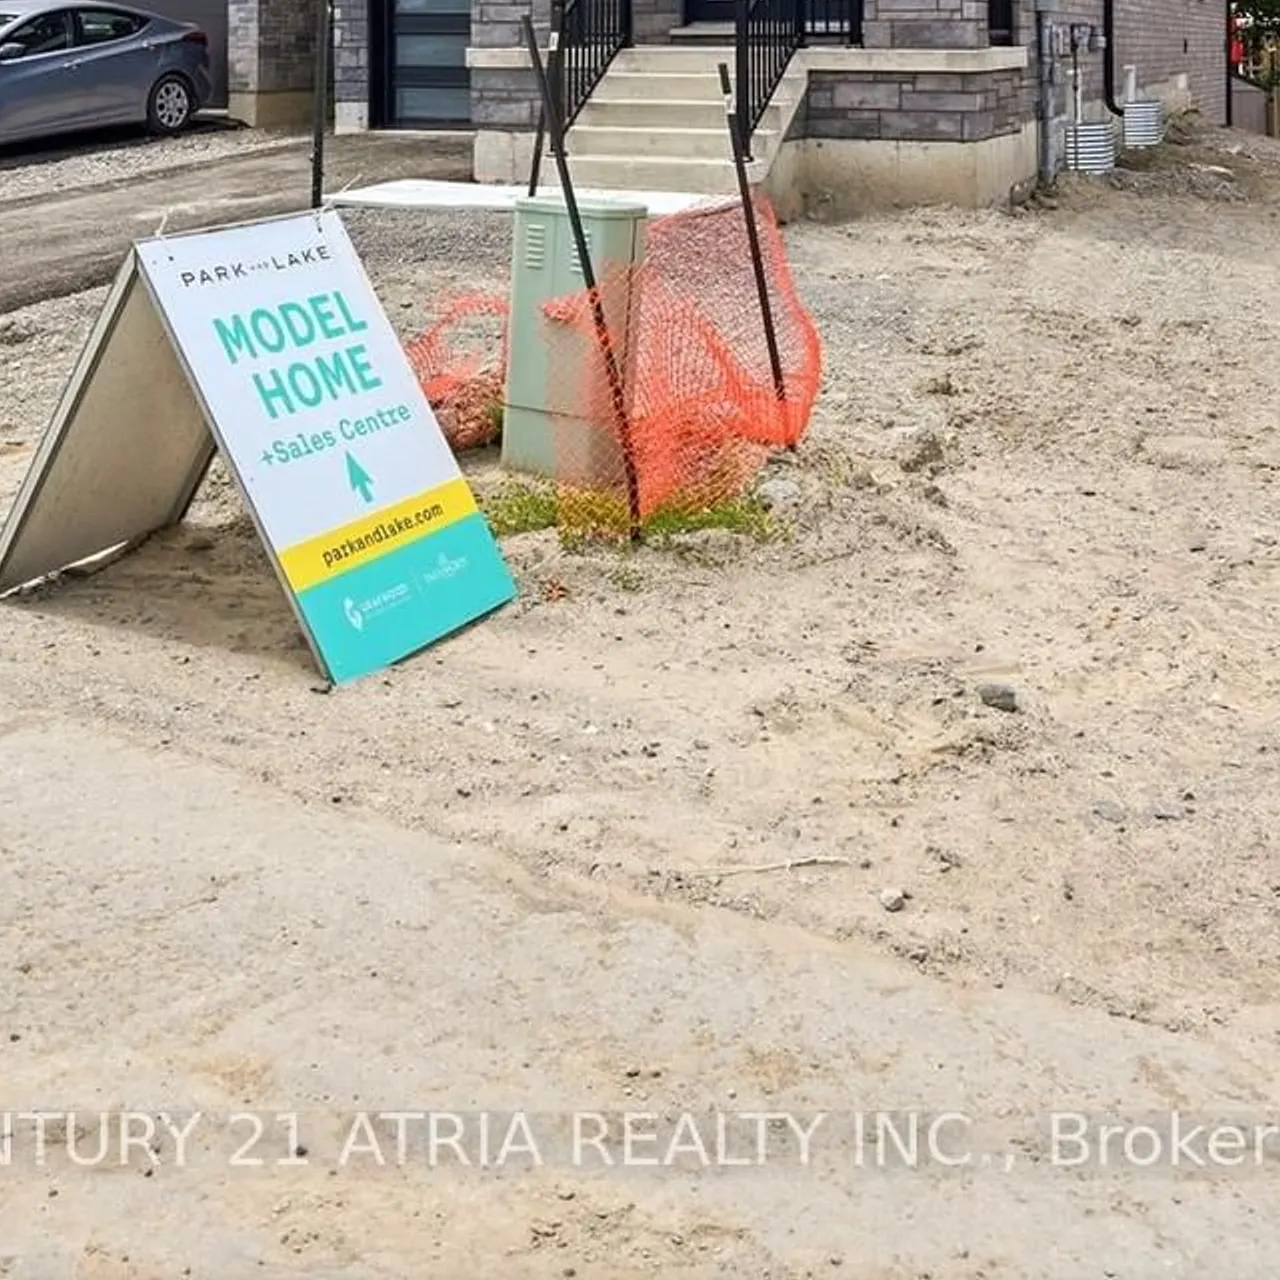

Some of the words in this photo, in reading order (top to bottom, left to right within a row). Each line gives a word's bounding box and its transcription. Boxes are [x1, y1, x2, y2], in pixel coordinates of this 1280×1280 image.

[180, 262, 248, 287] PARK
[271, 245, 331, 270] LAKE
[213, 290, 368, 364] MODEL
[252, 343, 383, 419] HOME
[260, 430, 337, 465] +Sales
[339, 404, 412, 441] Centre
[322, 503, 444, 568] parkandlake.com
